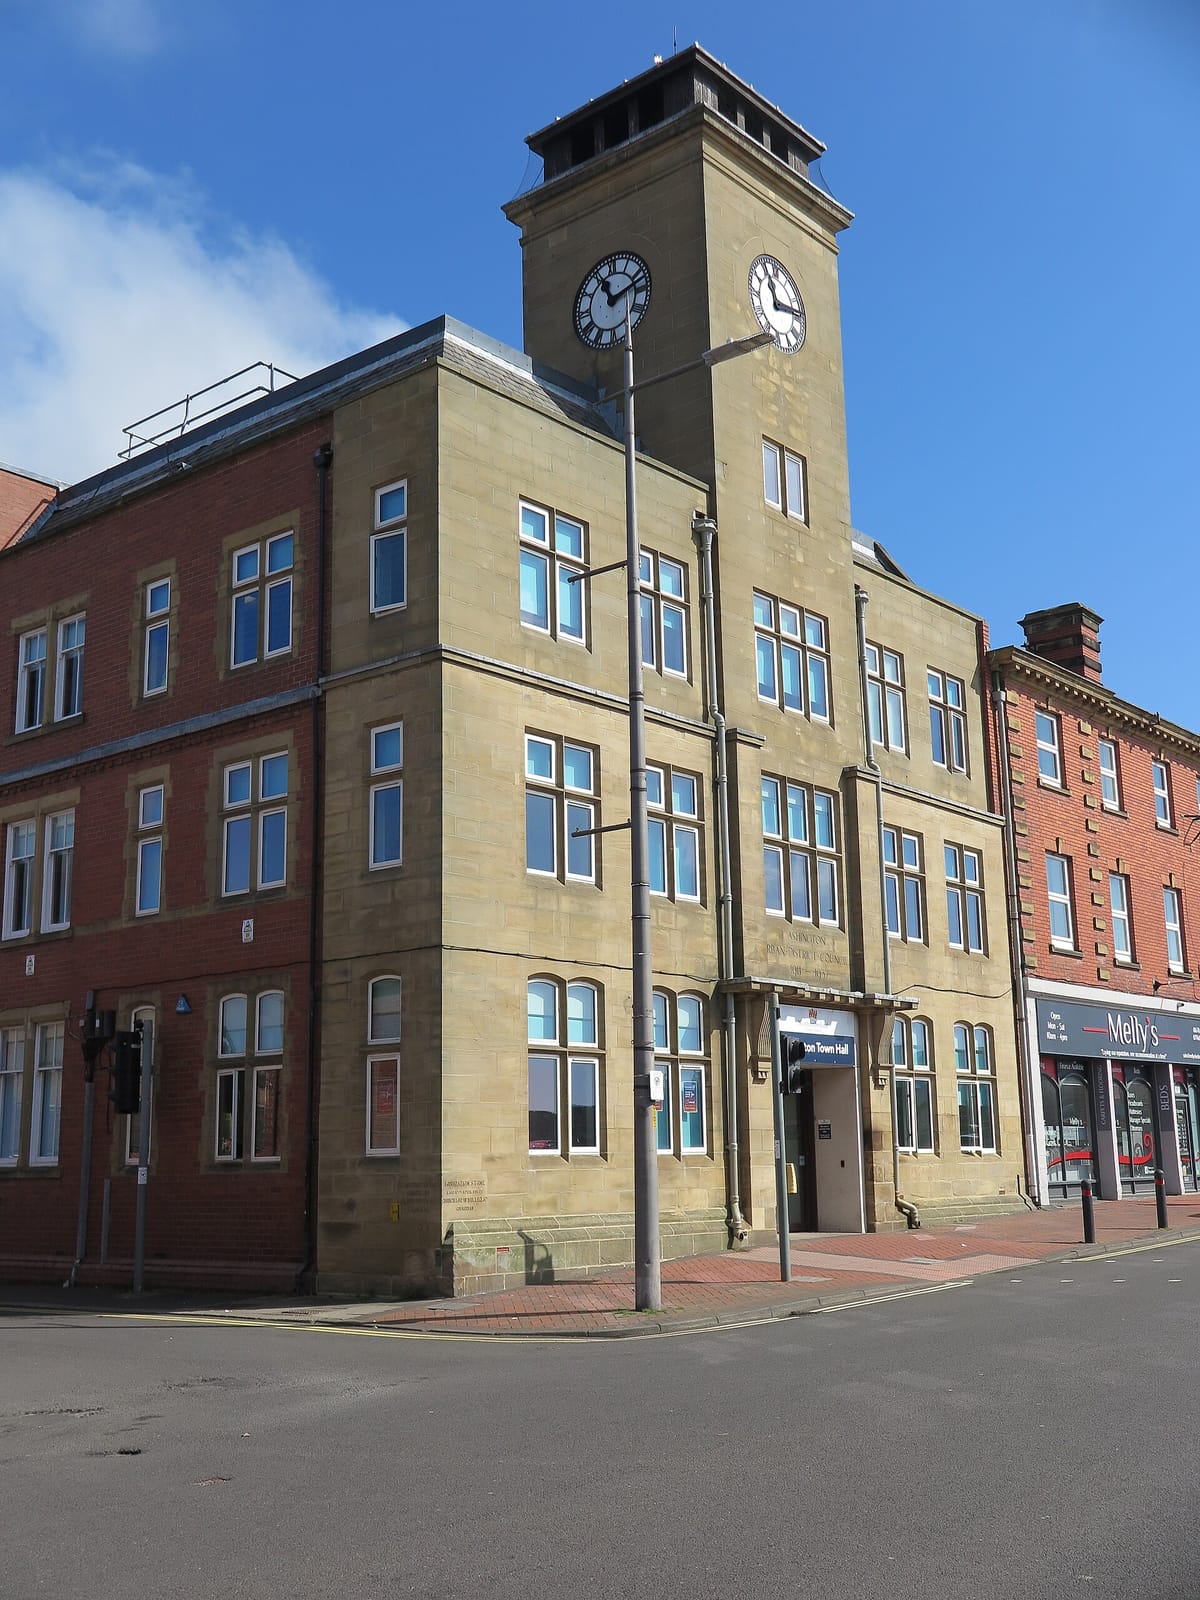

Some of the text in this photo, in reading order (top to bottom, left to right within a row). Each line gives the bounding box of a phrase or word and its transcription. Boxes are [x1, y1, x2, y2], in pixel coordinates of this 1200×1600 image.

[788, 930, 826, 945] ASHINGTON
[1050, 1011, 1061, 1021] Open
[1047, 1021, 1057, 1030] Mon
[1107, 1012, 1159, 1053] Melly's
[816, 1042, 835, 1054] Town
[836, 1043, 849, 1055] Hall
[1160, 1084, 1170, 1111] BEDS
